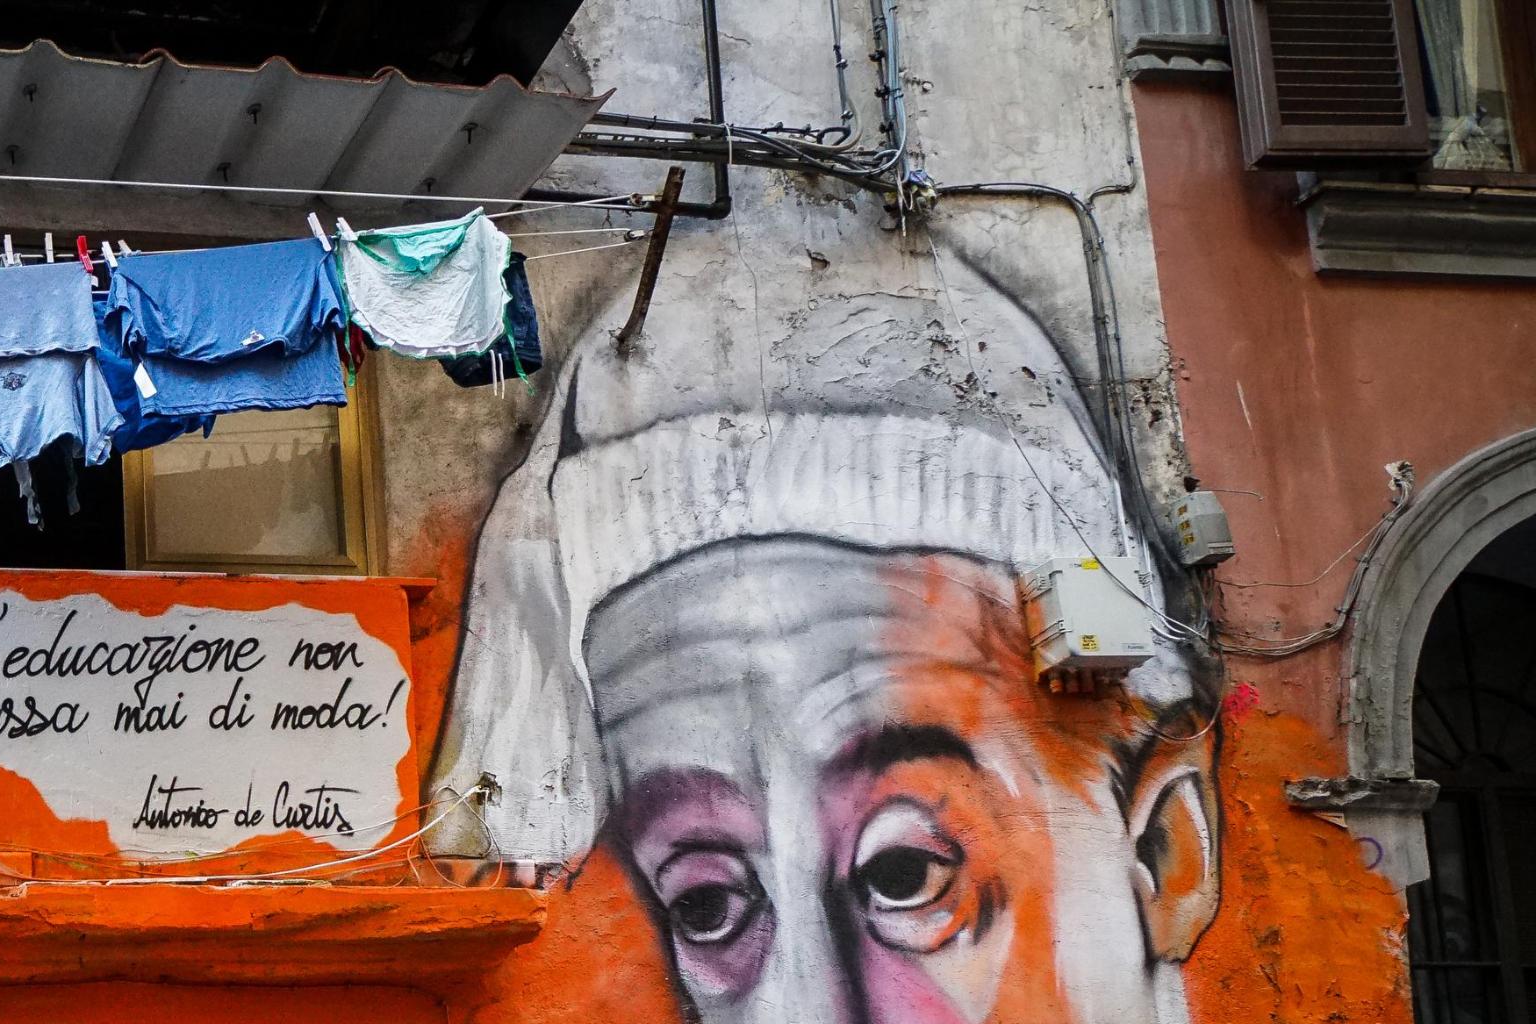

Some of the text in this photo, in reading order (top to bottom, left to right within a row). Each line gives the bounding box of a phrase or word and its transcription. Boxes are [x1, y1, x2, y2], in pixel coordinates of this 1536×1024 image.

[288, 638, 365, 671] non
[113, 693, 188, 734] mai
[209, 677, 255, 732] di
[271, 678, 407, 732] moda!
[234, 788, 265, 828] de
[272, 781, 360, 836] Curtis
